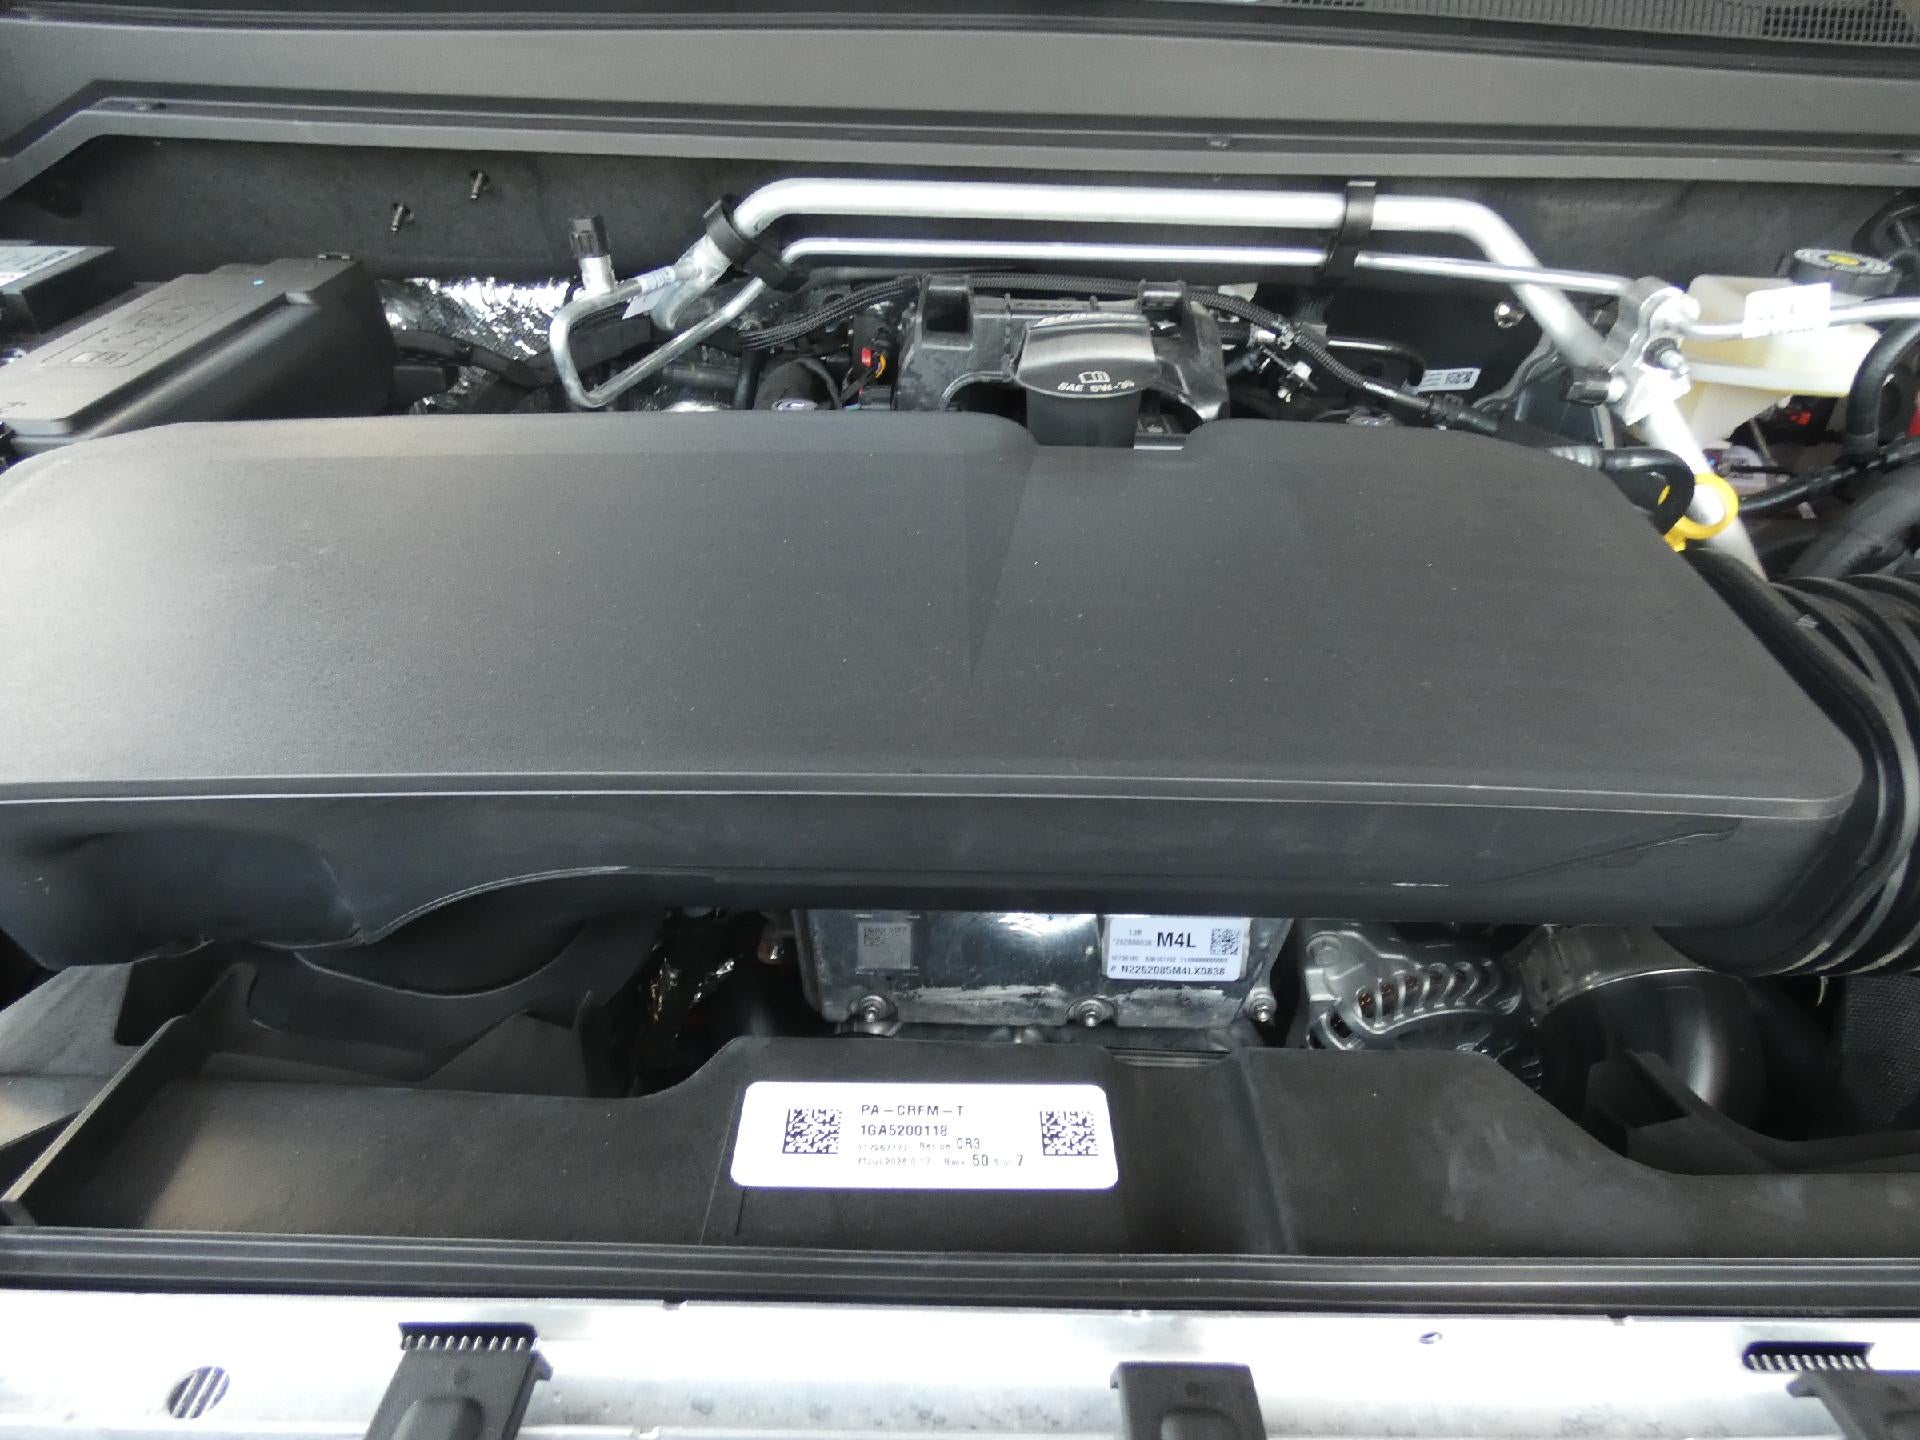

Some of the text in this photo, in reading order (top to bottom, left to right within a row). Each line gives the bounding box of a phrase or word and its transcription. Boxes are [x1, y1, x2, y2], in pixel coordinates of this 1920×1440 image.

[1057, 381, 1085, 392] SAE
[1157, 931, 1197, 948] M4L
[860, 1124, 948, 1136] 1GA5200118
[957, 1137, 980, 1150] CR3
[972, 1153, 989, 1167] 50
[1016, 1153, 1025, 1167] 7
